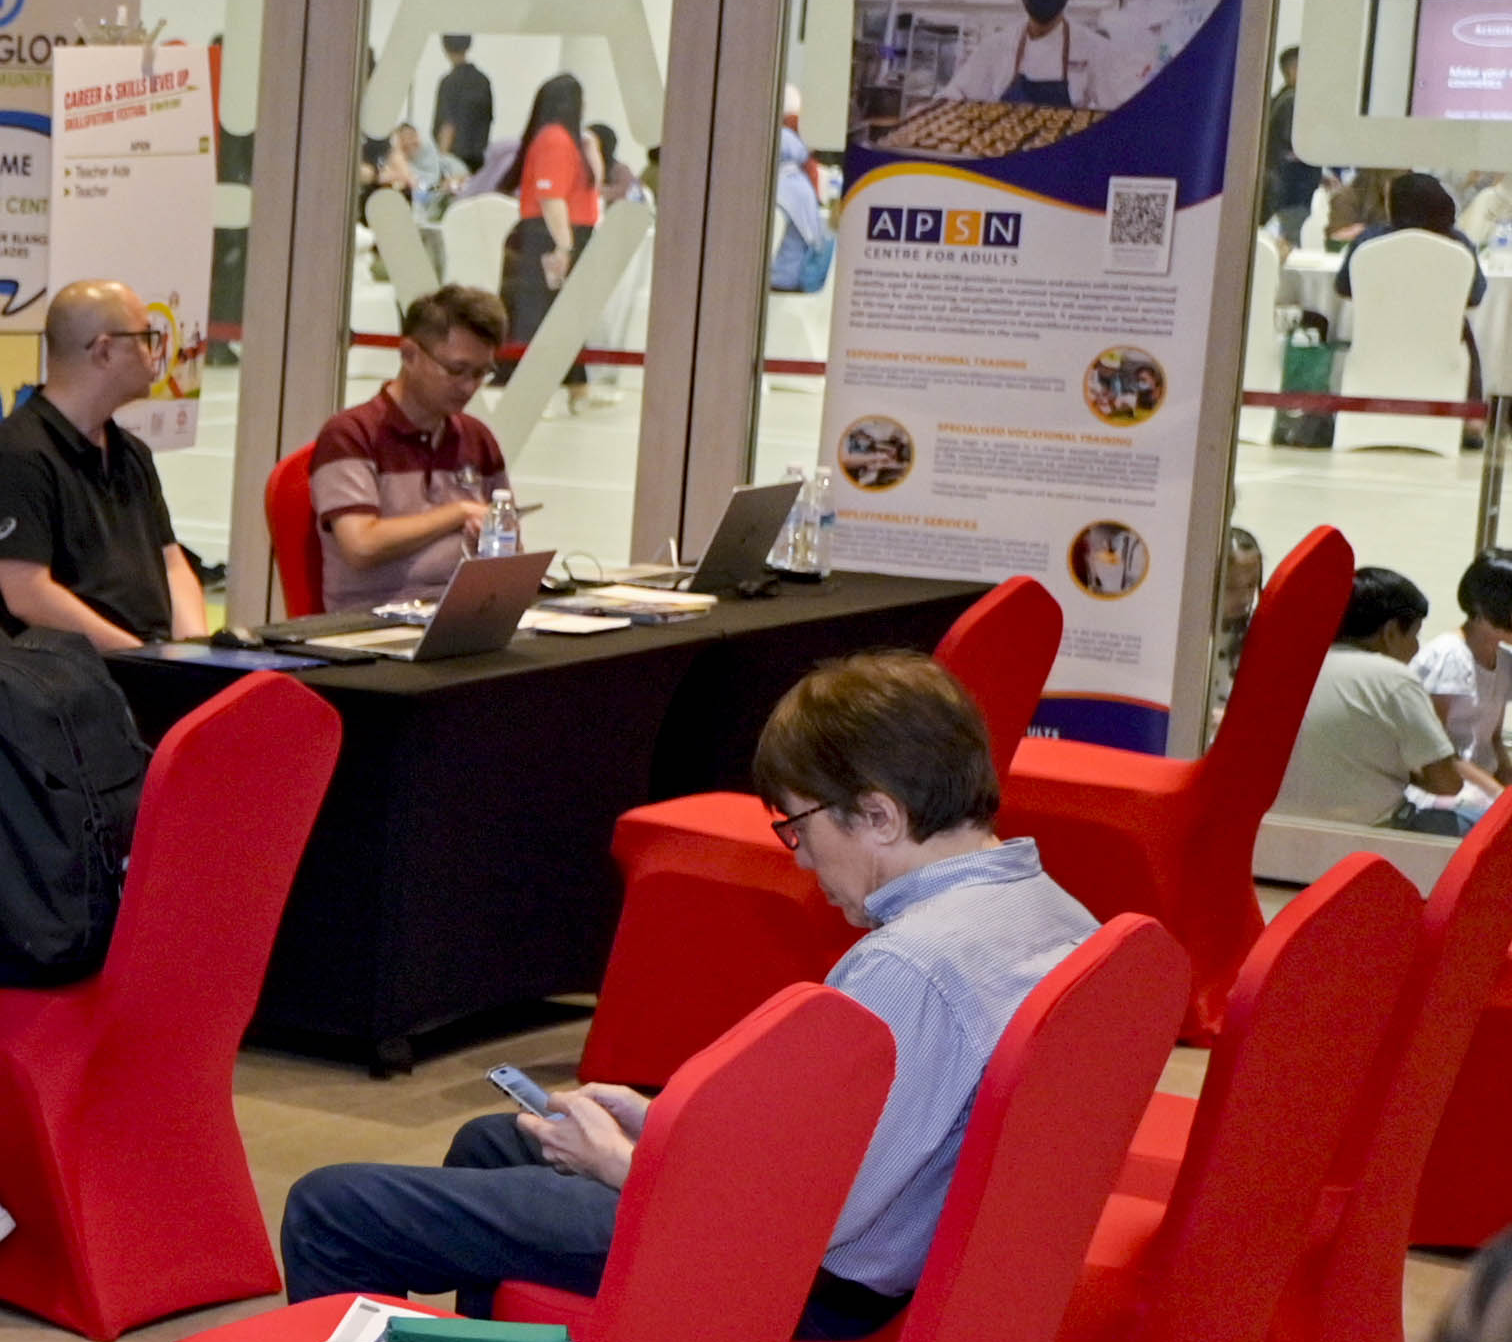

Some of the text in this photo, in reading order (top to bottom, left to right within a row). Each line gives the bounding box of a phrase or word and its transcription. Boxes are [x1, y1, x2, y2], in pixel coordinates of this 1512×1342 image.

[64, 86, 102, 110] CAREER
[115, 76, 147, 100] SKILLS
[0, 154, 31, 176] ME
[75, 185, 108, 198] Teacher
[871, 210, 1016, 244] APSN
[864, 247, 1017, 266] CENTRE FOR ADULTS
